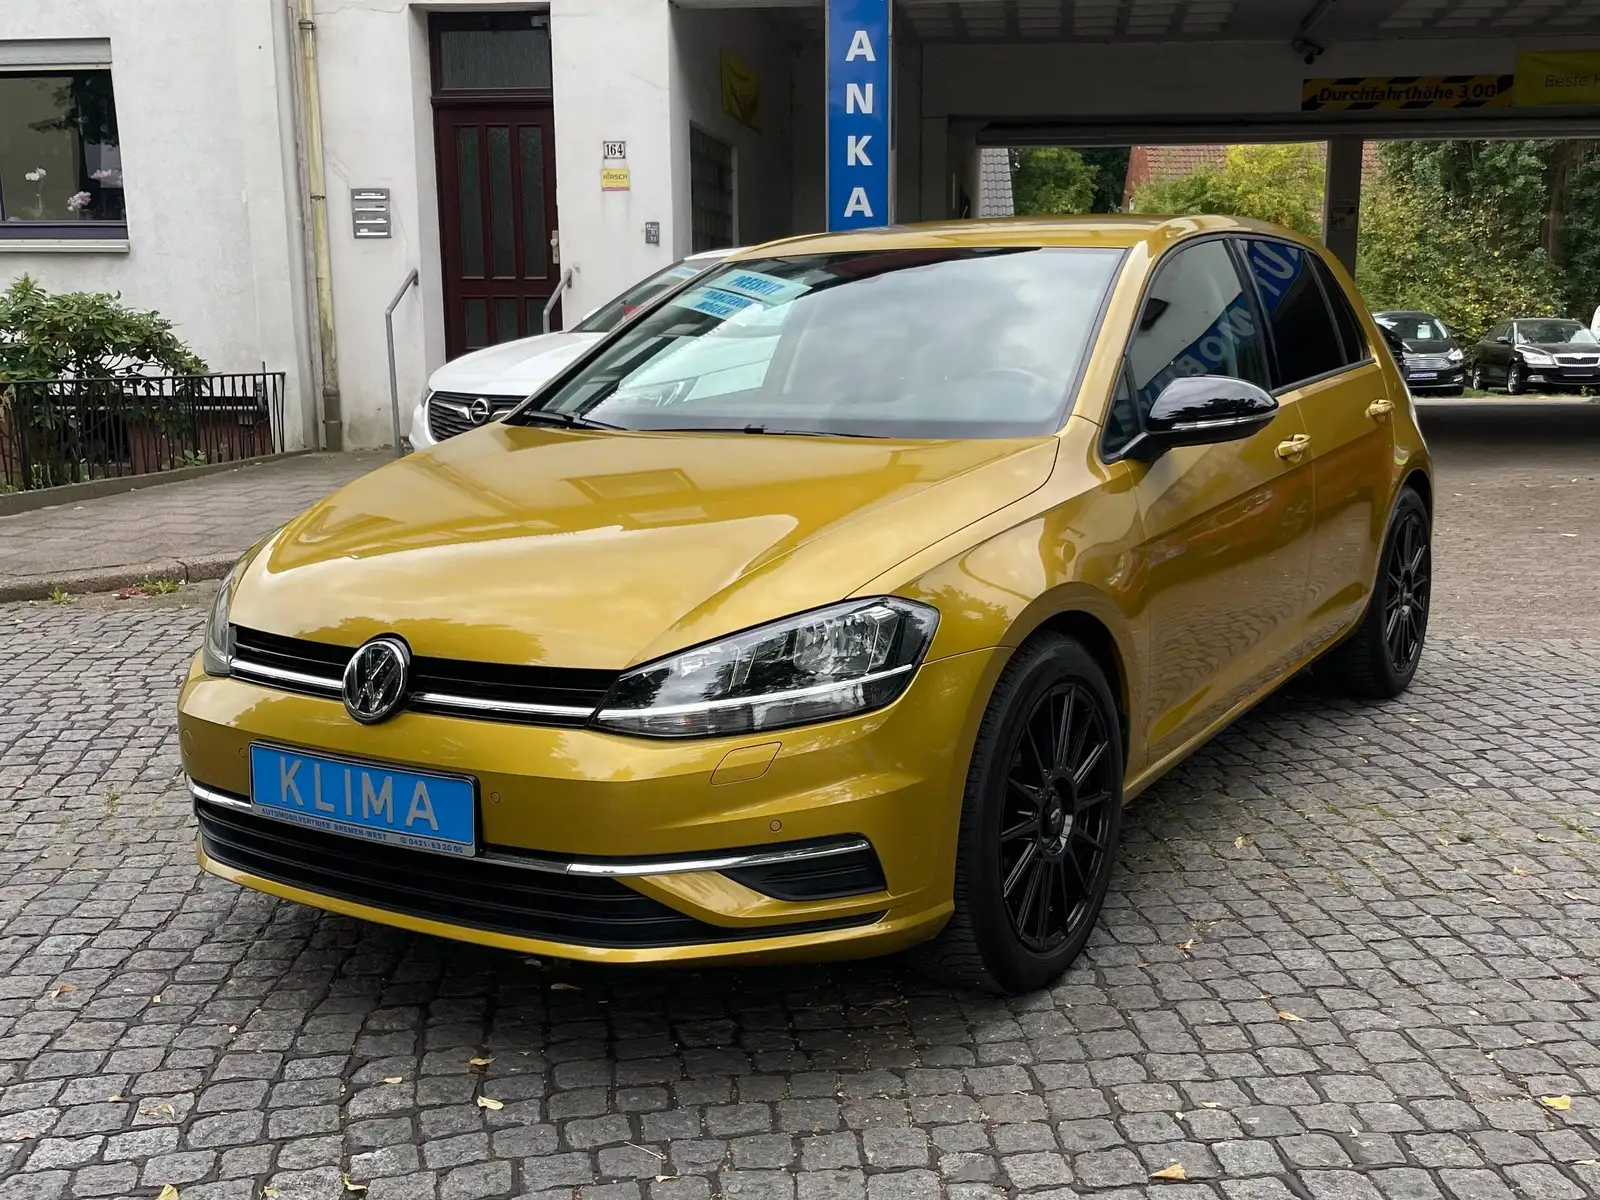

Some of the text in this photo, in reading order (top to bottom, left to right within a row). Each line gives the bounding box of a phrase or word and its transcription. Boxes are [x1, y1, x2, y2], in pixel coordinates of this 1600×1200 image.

[1545, 74, 1588, 88] Beste
[1319, 84, 1454, 102] Durchfahrthöhe
[605, 143, 624, 156] 164
[279, 756, 439, 831] KLIMA
